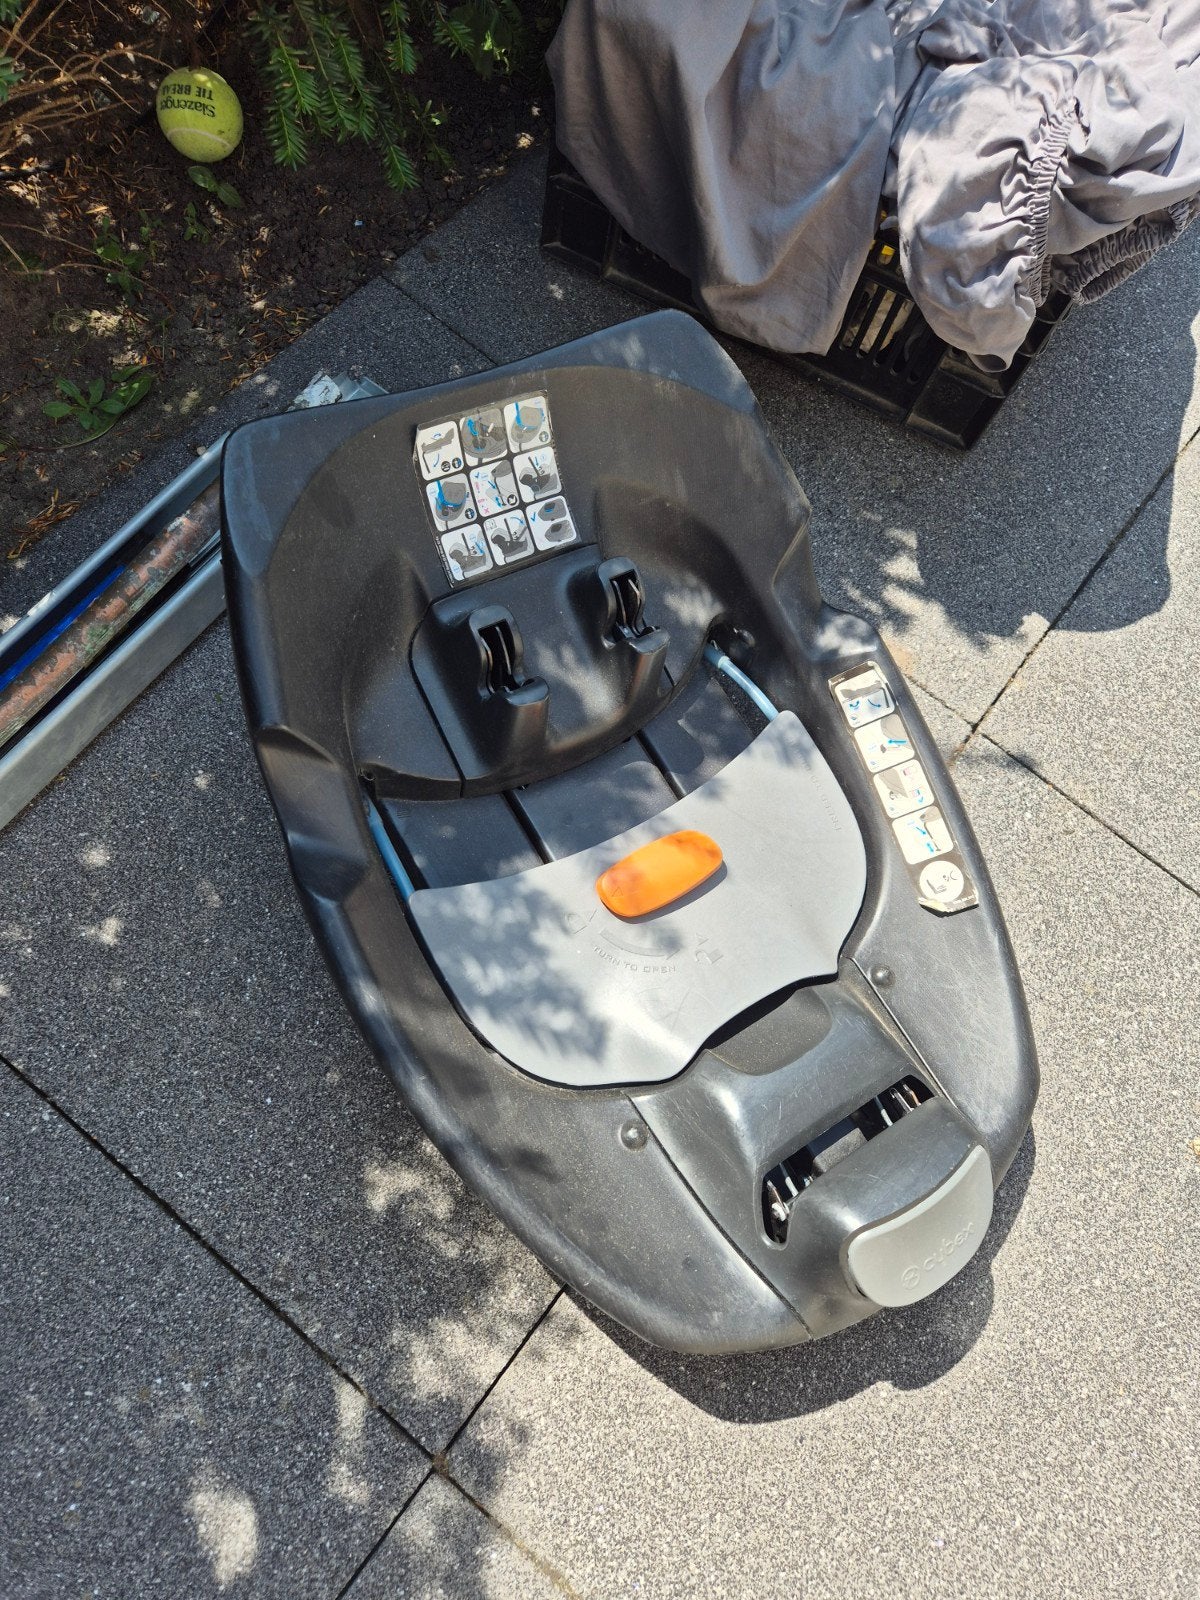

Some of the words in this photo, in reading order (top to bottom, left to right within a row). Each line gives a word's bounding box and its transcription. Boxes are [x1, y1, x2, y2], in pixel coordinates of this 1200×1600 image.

[195, 86, 214, 101] TIE
[593, 946, 622, 966] TURN
[624, 963, 638, 972] TO
[643, 965, 677, 974] OPEN
[923, 1221, 975, 1270] cybex
